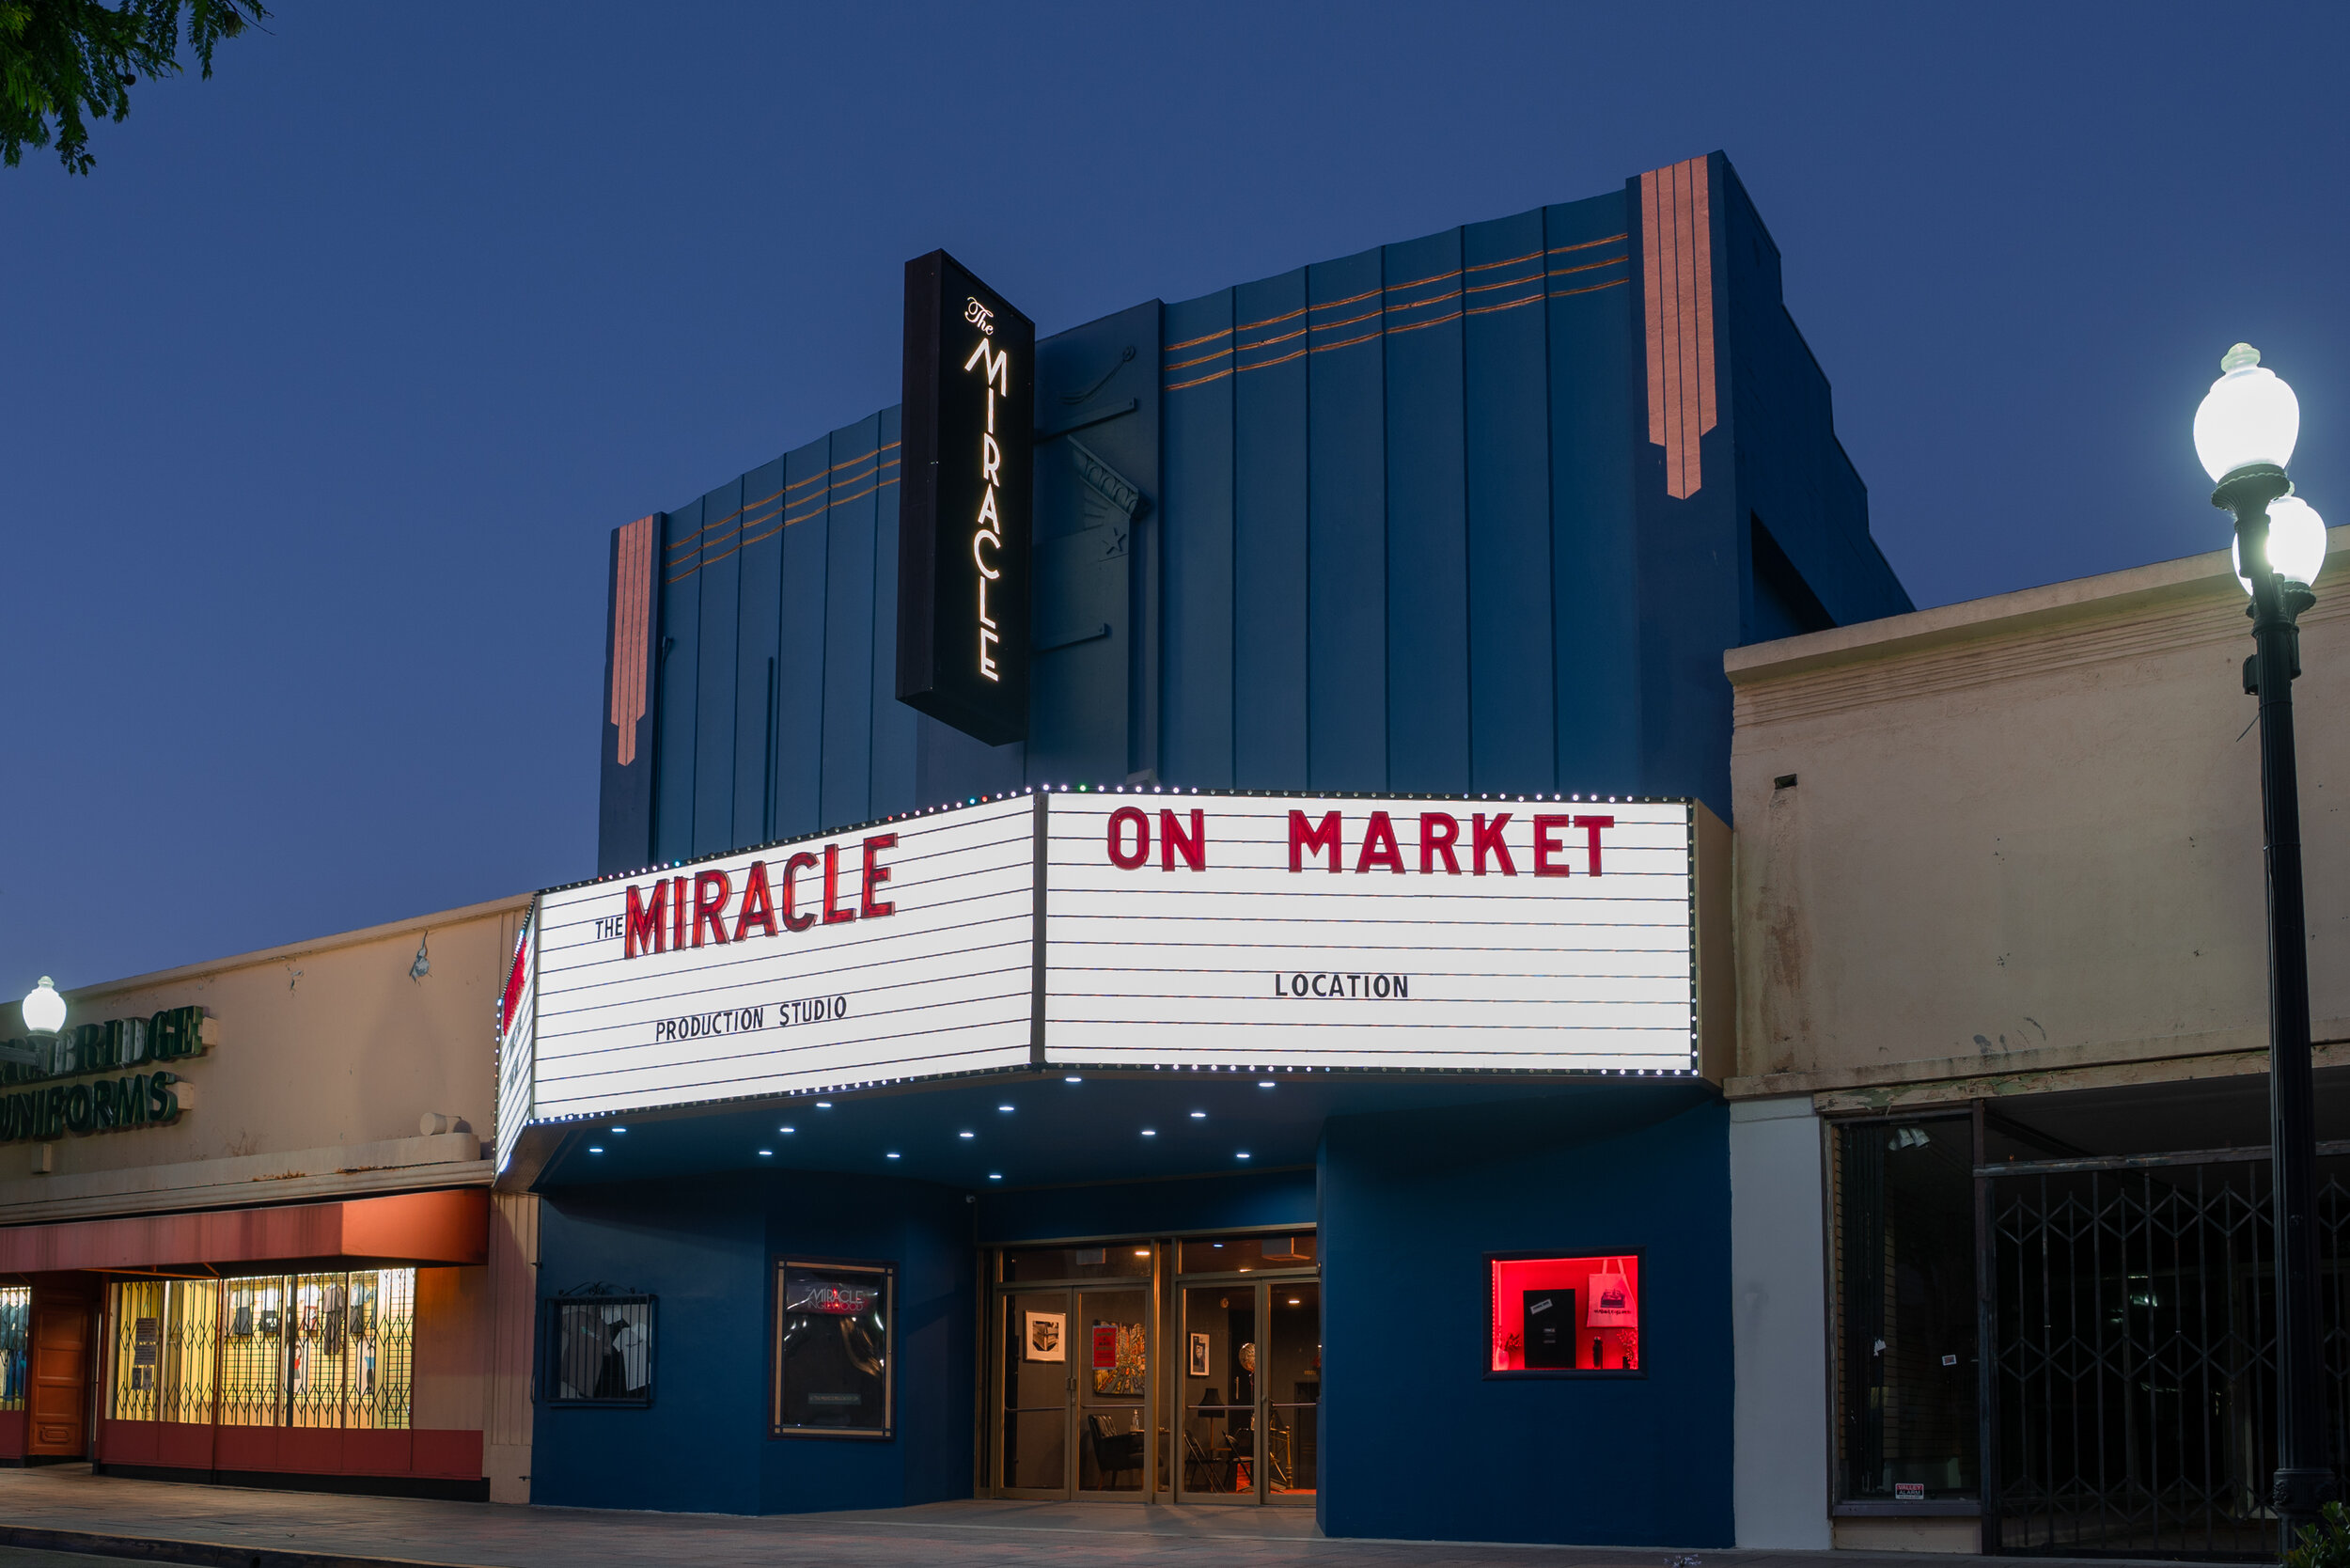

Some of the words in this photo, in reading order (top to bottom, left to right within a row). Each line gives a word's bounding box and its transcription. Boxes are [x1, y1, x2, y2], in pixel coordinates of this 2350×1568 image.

[964, 296, 994, 336] The
[964, 337, 1007, 682] MIRACLE
[1107, 806, 1206, 872] ON
[1289, 809, 1615, 878] MARKET
[595, 917, 623, 940] THE
[624, 833, 898, 960] MIRACLE
[655, 1006, 764, 1043] PRODUCTION
[778, 996, 848, 1026] STUDIO
[1275, 973, 1410, 999] LOCATION
[0, 1006, 204, 1083] BRIDGE
[0, 1071, 179, 1141] UNIFORMS
[809, 1289, 864, 1304] MIRACLE
